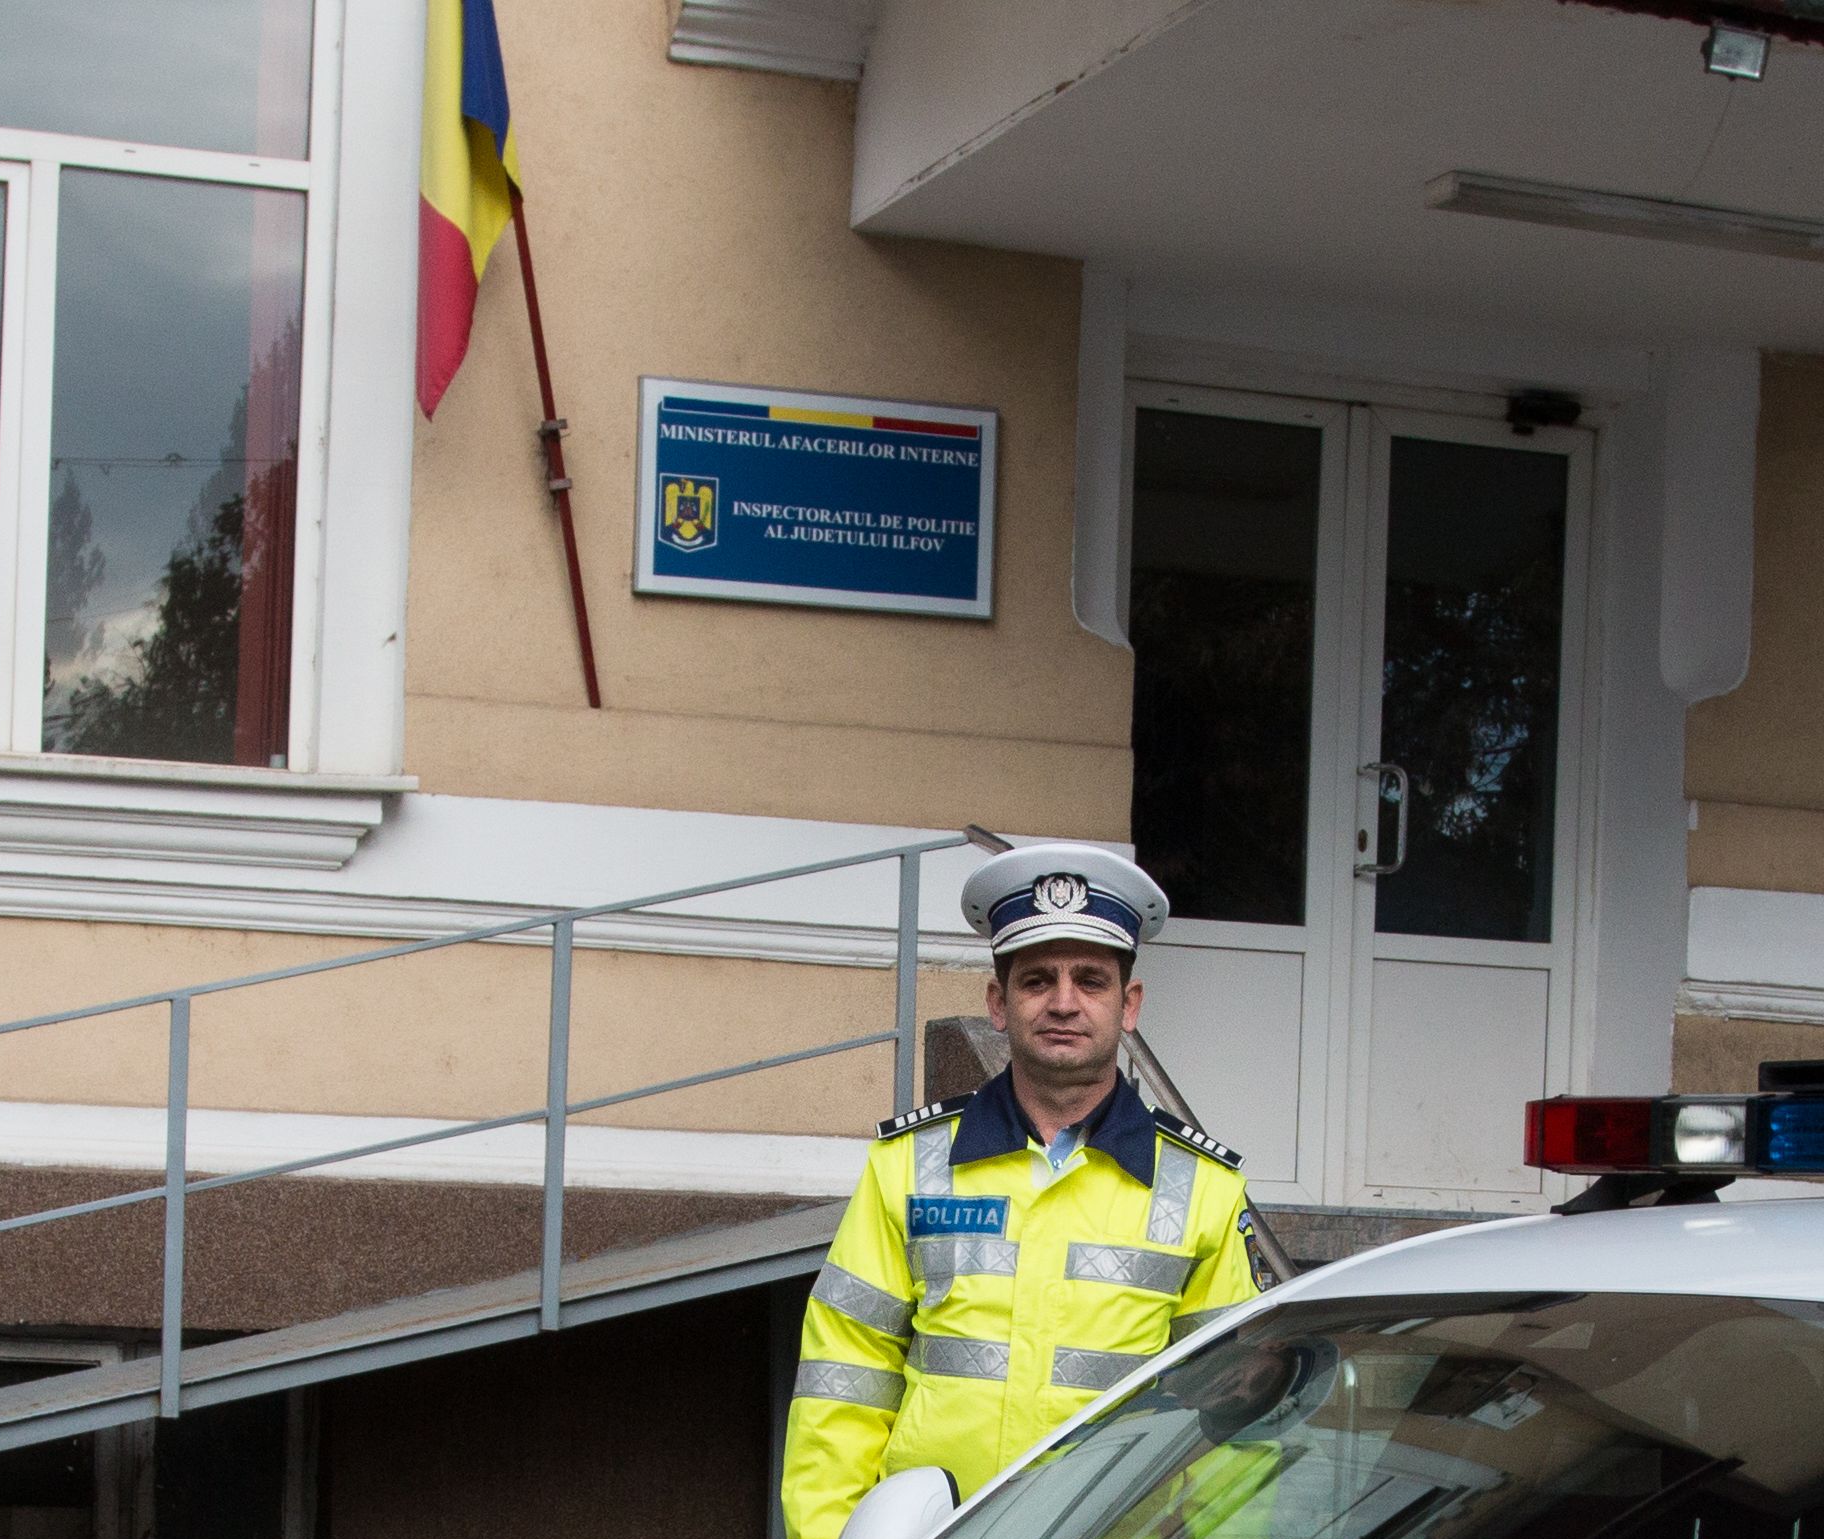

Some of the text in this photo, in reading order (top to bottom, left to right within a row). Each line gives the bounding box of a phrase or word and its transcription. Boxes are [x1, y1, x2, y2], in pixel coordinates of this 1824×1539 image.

[660, 422, 978, 467] MINISTERUL AFACERILOR INTERNE
[733, 501, 976, 536] INSPECTORATUL DE POLITIE
[764, 524, 945, 552] AL JUDETULUI ILFOV
[911, 1206, 999, 1227] POLITIA
